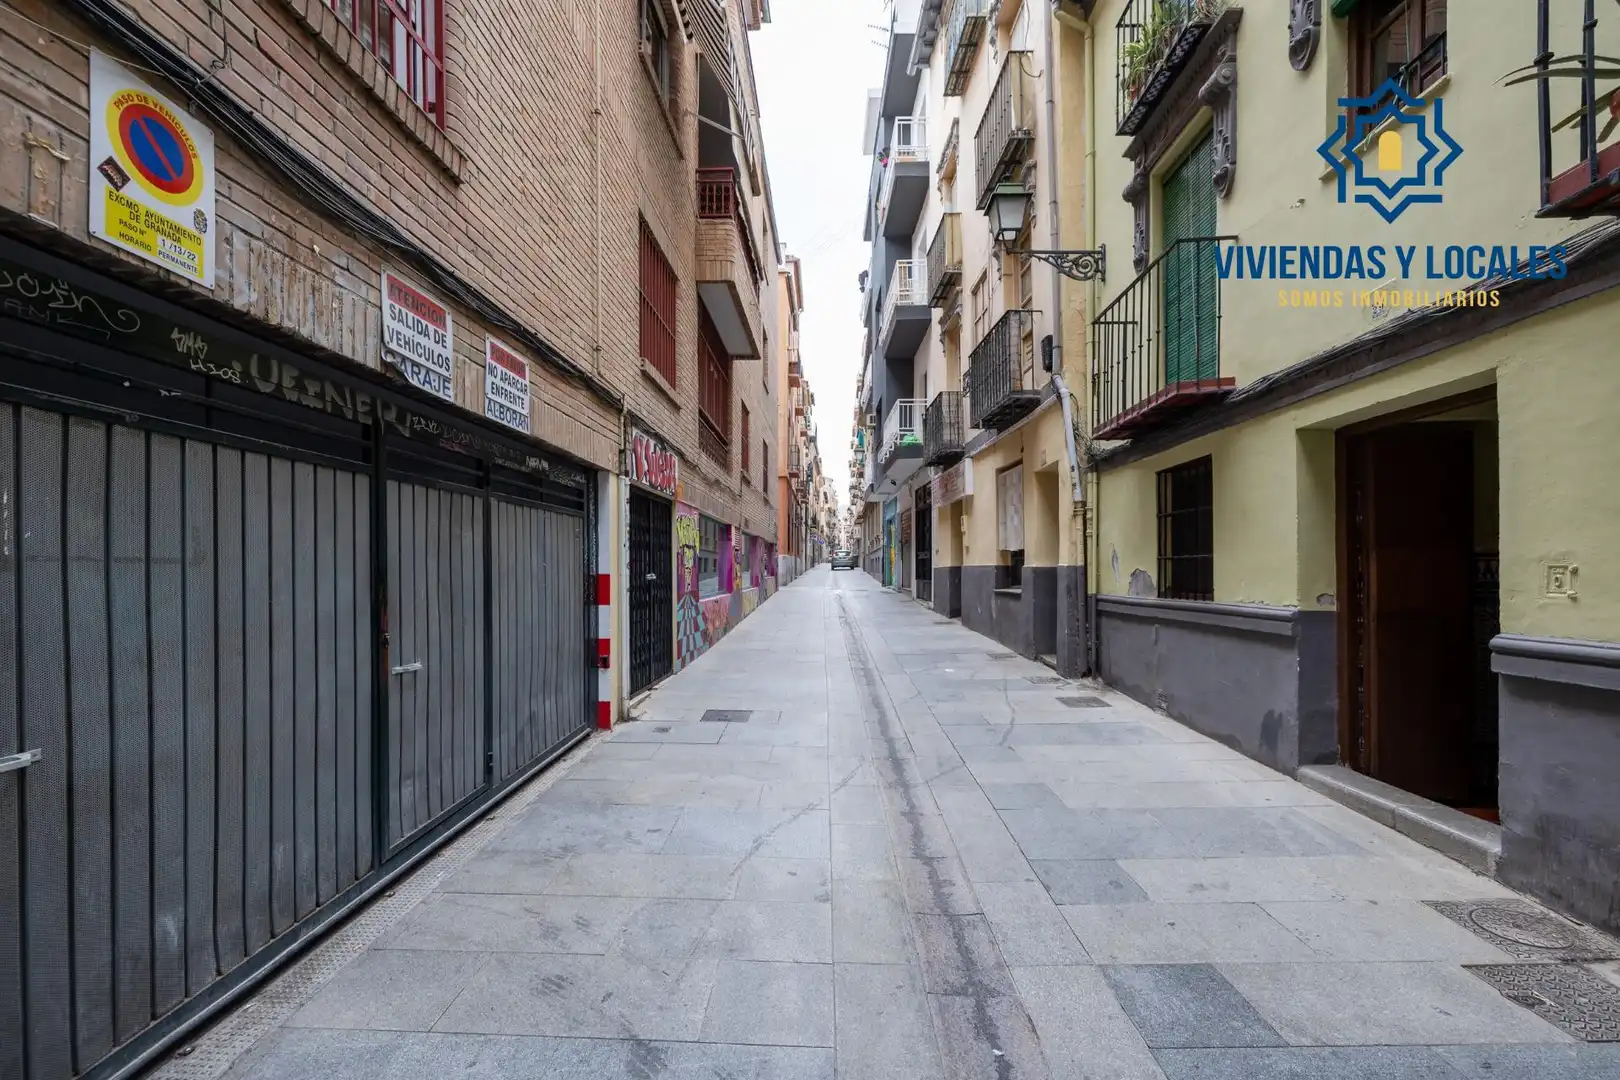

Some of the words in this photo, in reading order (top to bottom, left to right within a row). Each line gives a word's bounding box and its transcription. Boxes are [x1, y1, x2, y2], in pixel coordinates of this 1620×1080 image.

[113, 93, 134, 110] PASO
[136, 94, 150, 105] DE
[108, 190, 141, 215] EXCMO.
[144, 209, 202, 246] AYUNTAMIENTO
[118, 218, 138, 234] PASO
[129, 211, 141, 224] DE
[144, 218, 182, 245] GRANADA
[119, 231, 152, 253] HORARIO
[158, 249, 198, 274] PERMANENTE
[389, 303, 430, 341] SALIDA
[434, 328, 447, 350] DE
[387, 324, 450, 373] VEHÍCULOS
[488, 362, 498, 378] NO
[500, 370, 528, 396] APARCAR
[491, 382, 525, 410] ENFRENTE
